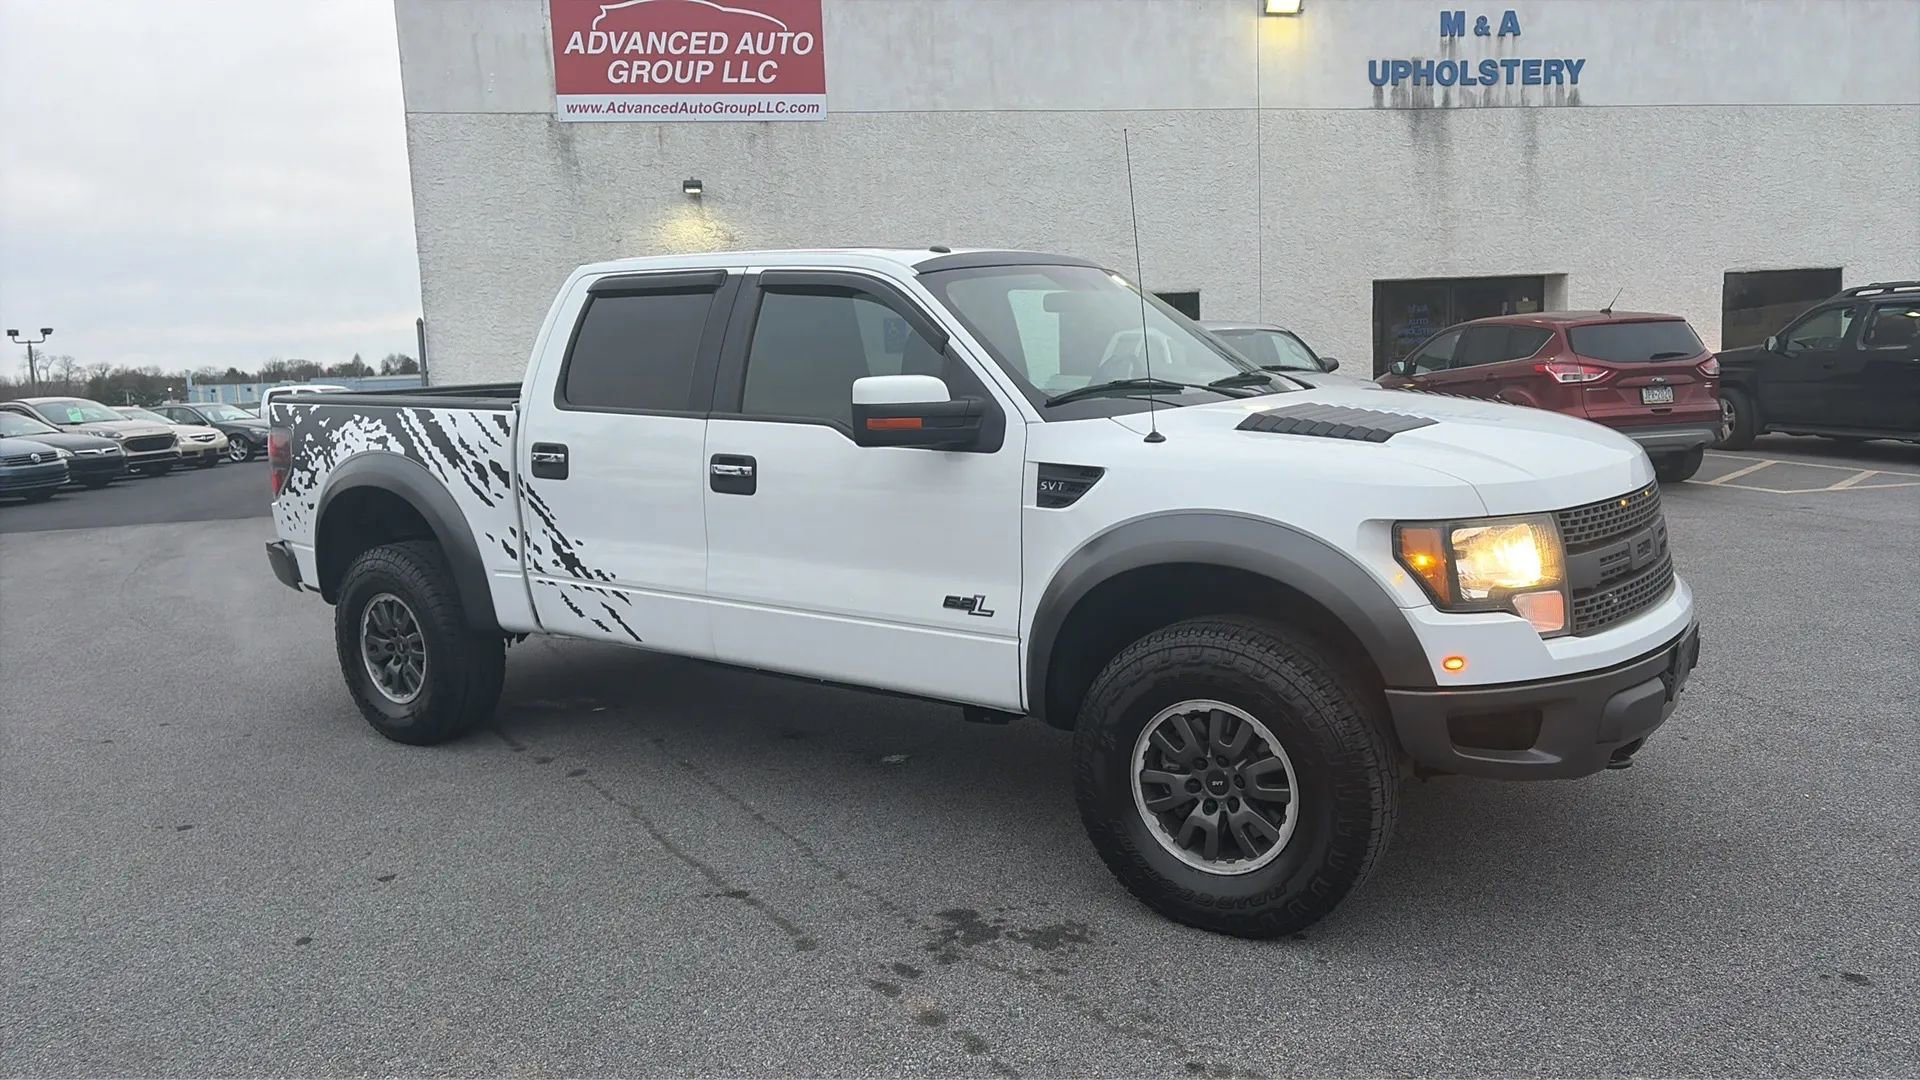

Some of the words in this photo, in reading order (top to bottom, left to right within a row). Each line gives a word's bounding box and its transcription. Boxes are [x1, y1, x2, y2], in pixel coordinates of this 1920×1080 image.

[1440, 10, 1466, 37] M
[1473, 15, 1492, 37] &
[1497, 10, 1521, 37] A
[564, 31, 729, 55] ADVANCED
[735, 31, 814, 56] AUTO
[607, 60, 714, 84] GROUP
[722, 60, 779, 84] LLC
[1368, 59, 1587, 87] UPHOLSTERY
[566, 101, 820, 117] www.AdvancedAutoGroupLLC.com
[1040, 481, 1065, 491] SVT
